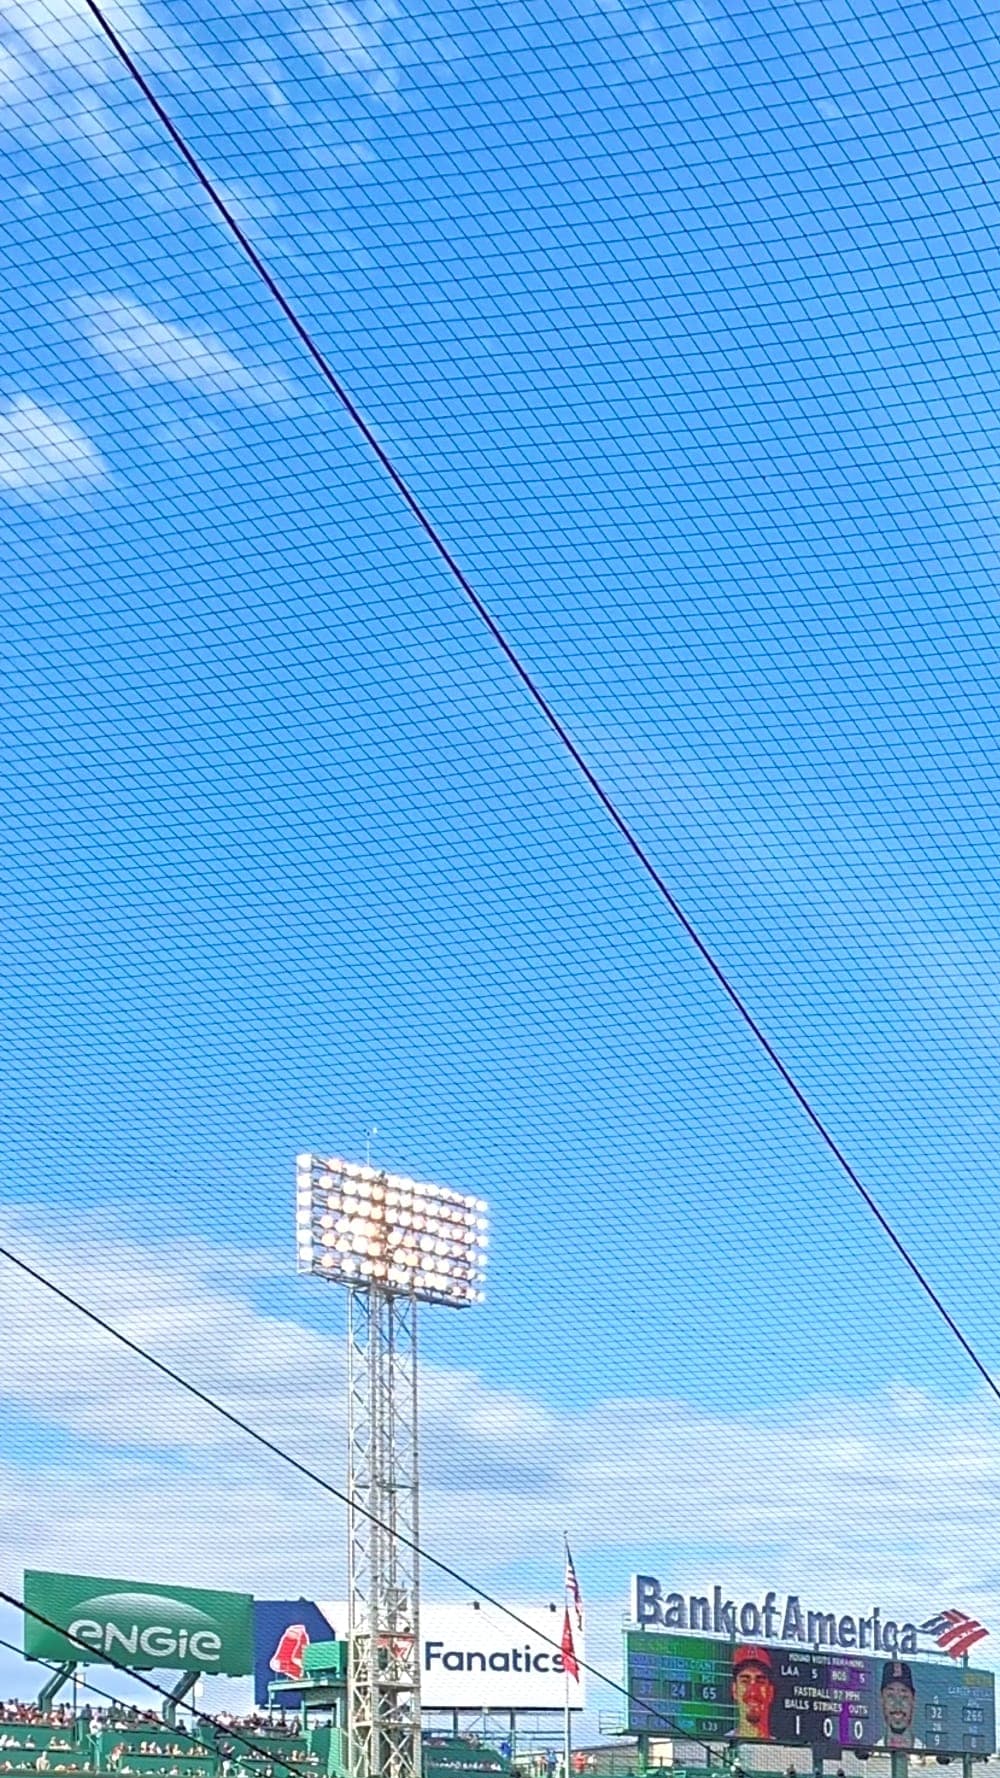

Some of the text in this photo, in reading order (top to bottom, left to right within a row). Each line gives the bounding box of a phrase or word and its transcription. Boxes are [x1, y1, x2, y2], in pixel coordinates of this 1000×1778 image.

[634, 1574, 918, 1654] Bank of America
[425, 1642, 564, 1674] Fanatics
[781, 1665, 799, 1676] LAA
[812, 1669, 818, 1679] 5
[702, 1687, 716, 1700] 65
[794, 1686, 830, 1698] FASTBALL
[784, 1699, 809, 1710] BALLS
[848, 1704, 868, 1714] OUTS
[931, 1707, 942, 1719] 32
[823, 1718, 833, 1737] 0
[854, 1721, 863, 1739] 0
